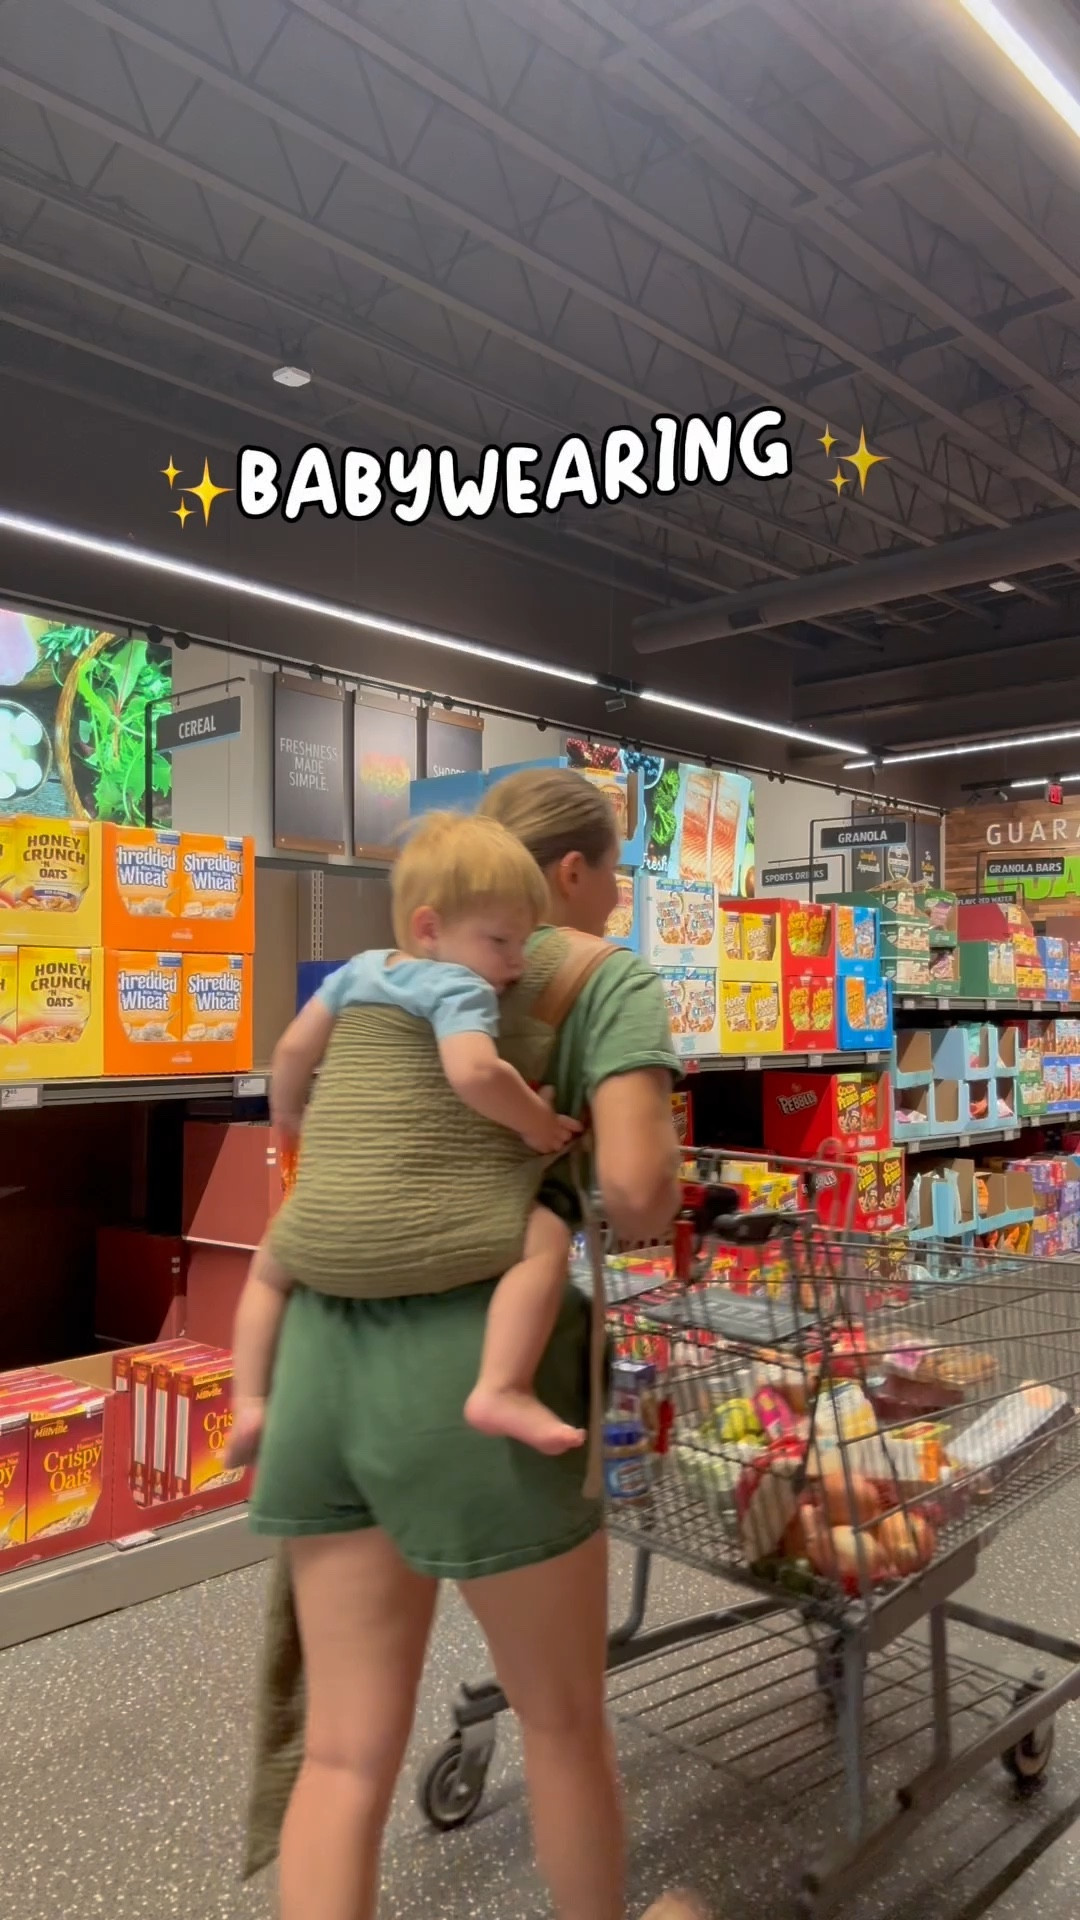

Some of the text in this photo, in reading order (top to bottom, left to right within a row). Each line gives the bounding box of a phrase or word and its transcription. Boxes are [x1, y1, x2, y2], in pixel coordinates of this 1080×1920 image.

[178, 715, 217, 739] CEREAL
[279, 737, 338, 761] FRESHNESS
[294, 757, 325, 775] MADE
[289, 772, 329, 792] SIMPLE.
[27, 834, 81, 849] HONEY
[838, 830, 888, 844] GRANOLA
[986, 818, 1080, 845] GUAR
[23, 847, 86, 865] CRUNCH
[116, 846, 177, 871] hredded
[40, 868, 68, 879] OATS
[119, 865, 168, 888] Wheat
[765, 869, 825, 883] SPORTS DRIKS
[989, 862, 1062, 874] GRANOLA BARS
[192, 871, 237, 892] Wheat
[991, 895, 1014, 903] WATER
[35, 962, 87, 977] HONEY
[31, 977, 90, 992] CRUNCH
[188, 973, 242, 993] Shredde
[46, 997, 74, 1007] OATS
[121, 990, 169, 1010] Wheat
[196, 991, 240, 1011] Wheat
[203, 1409, 233, 1432] Cris
[44, 1445, 102, 1473] Crispy
[50, 1468, 92, 1493] Oats
